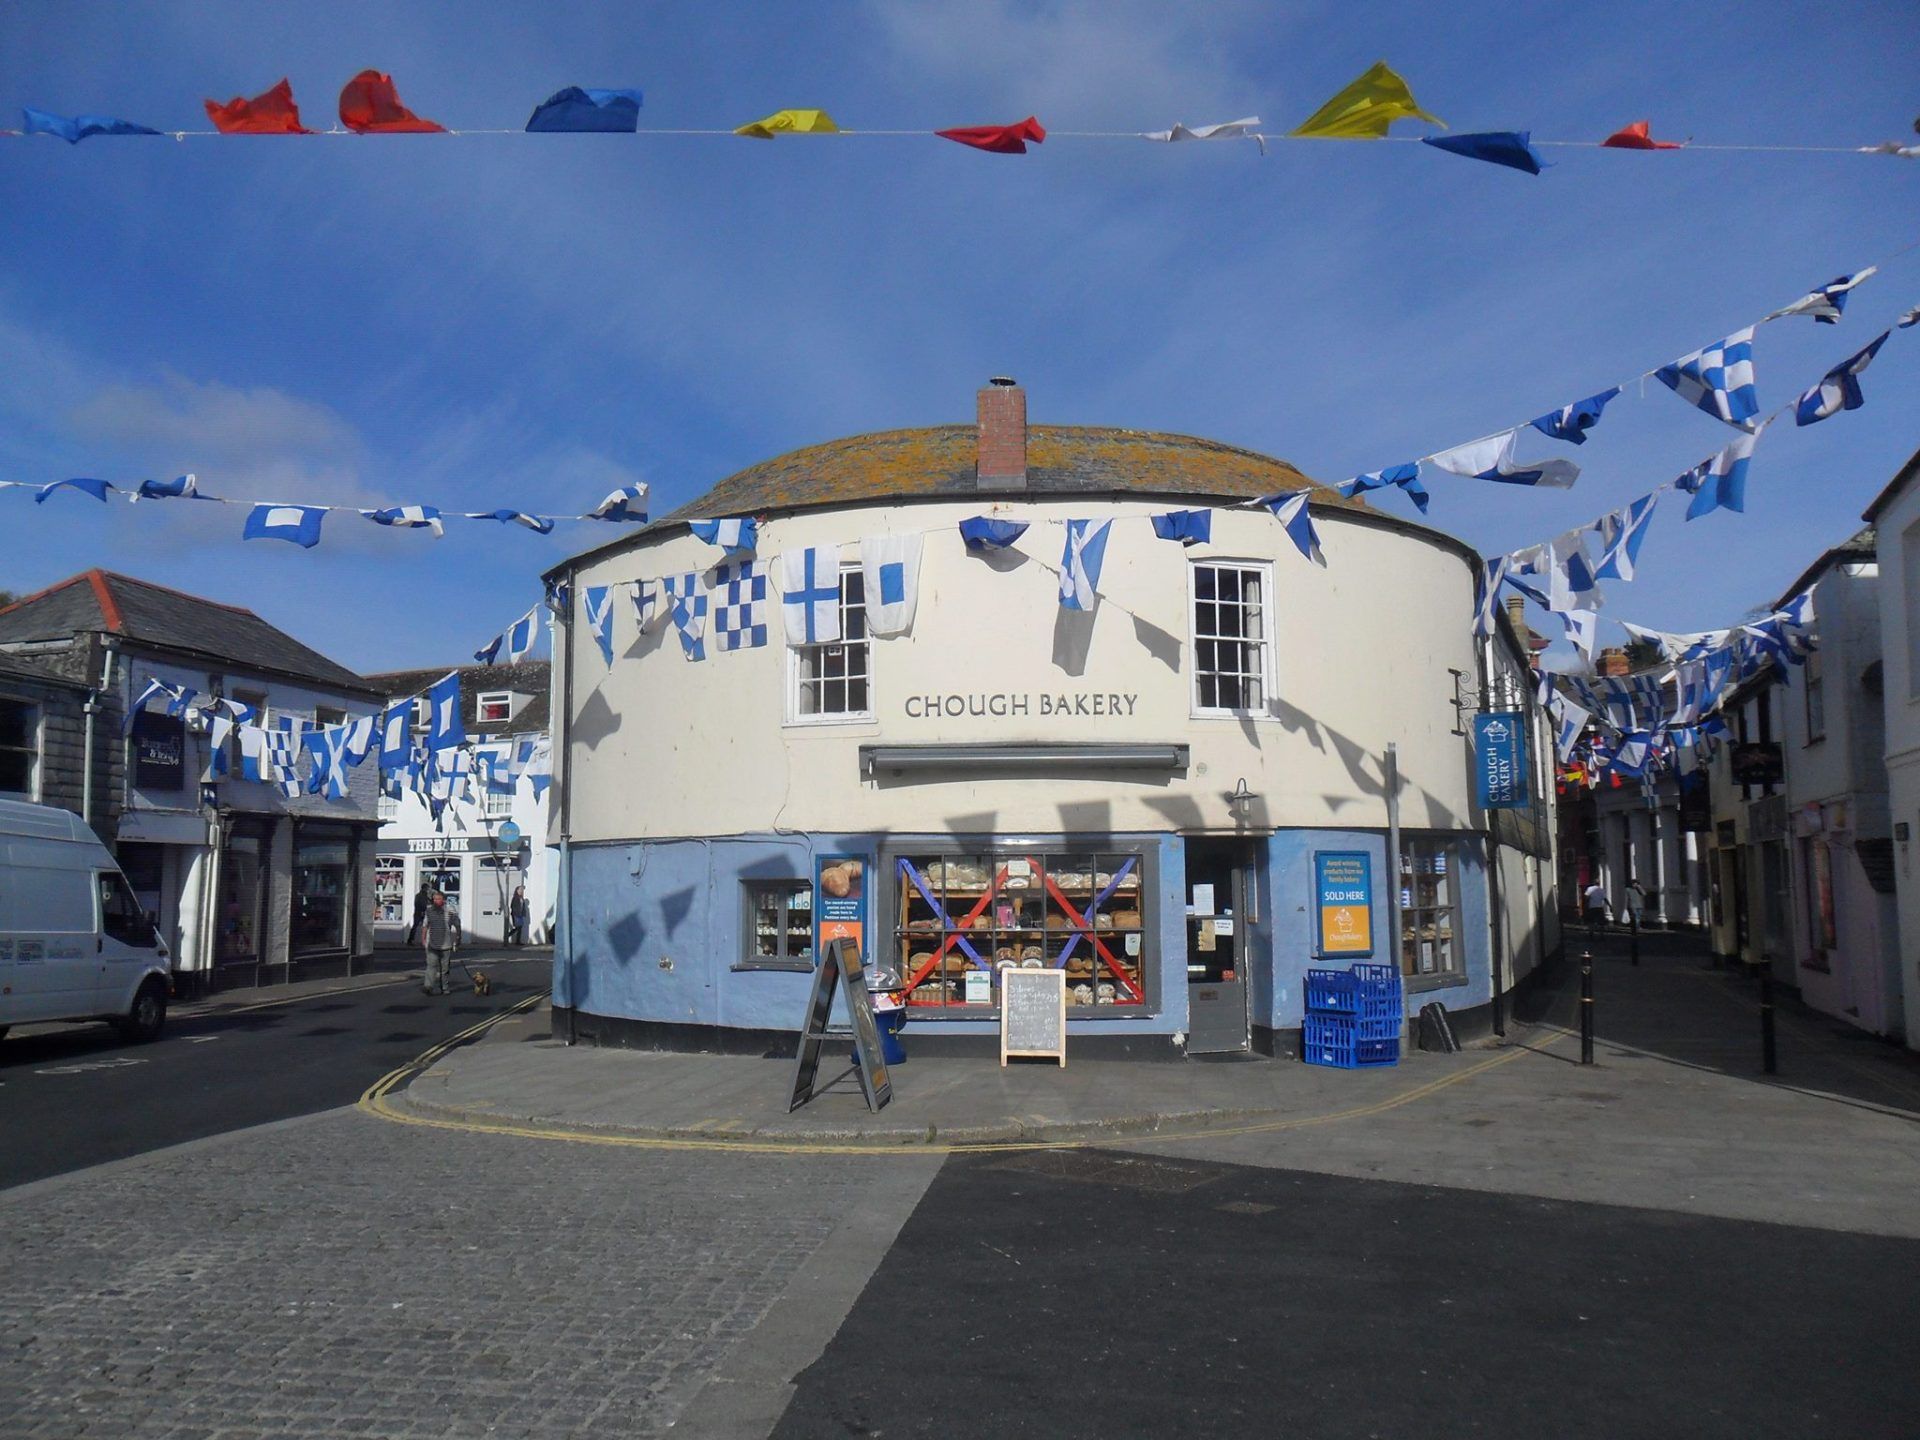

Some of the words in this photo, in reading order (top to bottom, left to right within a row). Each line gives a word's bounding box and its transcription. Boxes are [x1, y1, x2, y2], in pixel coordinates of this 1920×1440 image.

[904, 694, 1029, 718] CHOUGH
[1040, 693, 1138, 716] BAKERY
[1487, 747, 1499, 802] CHOUGH
[1499, 758, 1512, 802] BAKERY
[408, 839, 433, 852] THE
[434, 838, 469, 852] BANK
[1324, 890, 1345, 901] SOLD
[1345, 890, 1365, 901] HERE
